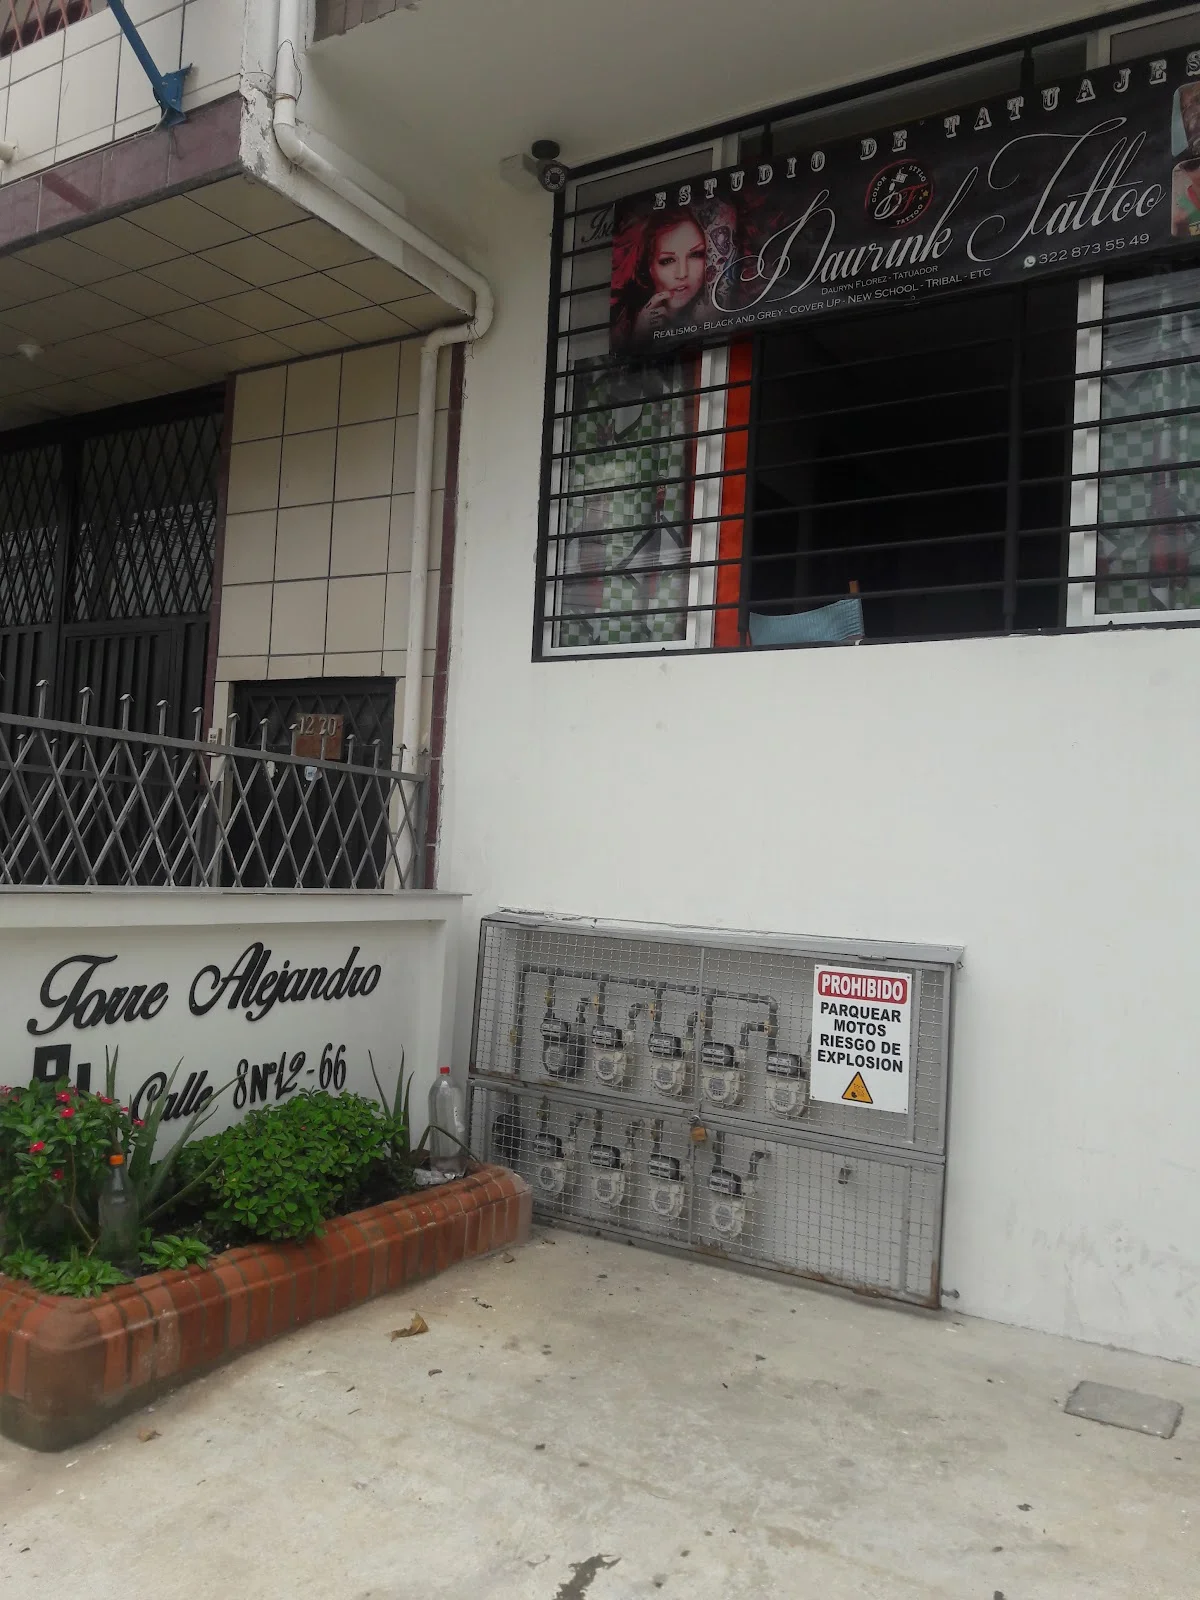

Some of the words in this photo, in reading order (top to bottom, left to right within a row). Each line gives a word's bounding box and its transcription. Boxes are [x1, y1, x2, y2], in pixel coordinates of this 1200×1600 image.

[653, 151, 825, 210] ESTUDIO
[860, 129, 907, 160] DE
[871, 176, 887, 203] COLOR
[908, 165, 927, 182] STYLO
[966, 116, 1167, 262] Tattoo
[896, 204, 923, 225] TATTOO
[1038, 250, 1068, 265] 322
[1071, 243, 1101, 258] 873
[1105, 238, 1125, 251] 55
[1129, 233, 1150, 246] 49
[27, 955, 168, 1035] Torre
[188, 942, 382, 1022] Alejandro
[821, 974, 904, 1001] PROHIBIDO
[820, 1001, 902, 1023] PARQUEAR
[834, 1019, 887, 1037] MOTOS
[820, 1034, 876, 1052] RIESGO
[881, 1042, 901, 1056] DE
[817, 1049, 904, 1073] EXPLOSION
[131, 1070, 213, 1122] Calle
